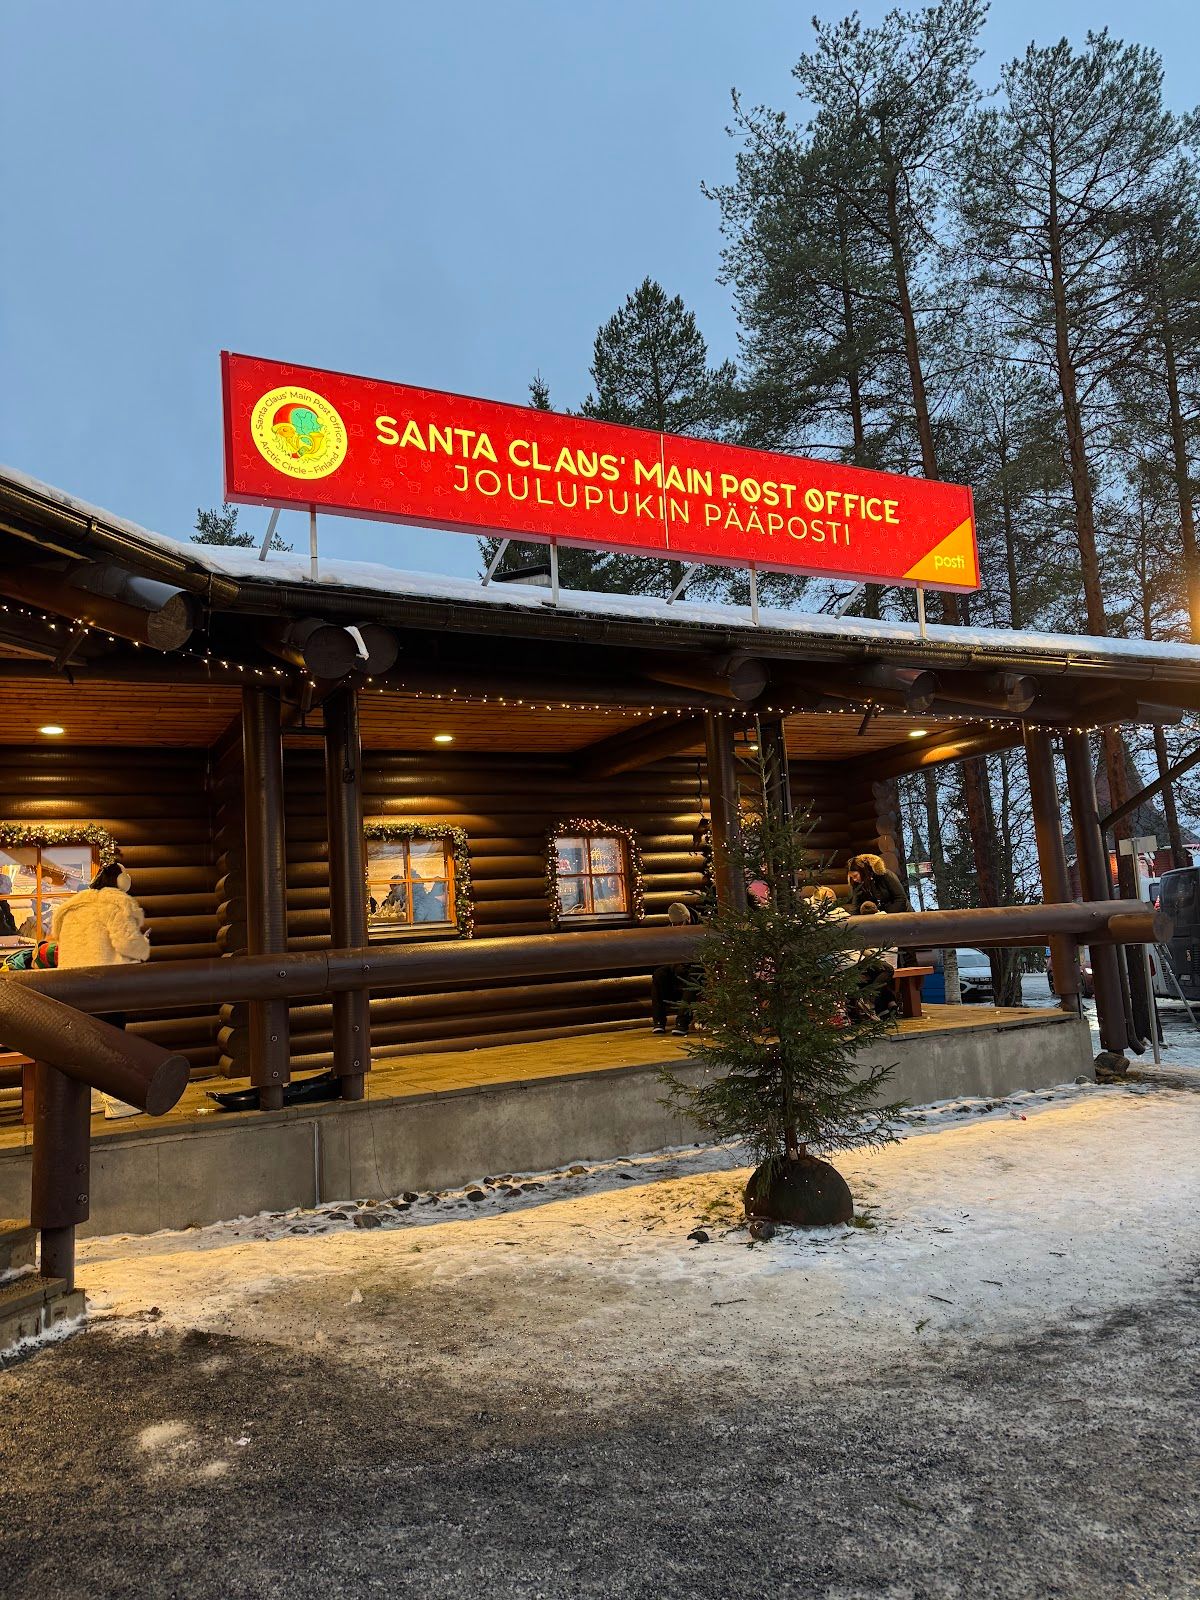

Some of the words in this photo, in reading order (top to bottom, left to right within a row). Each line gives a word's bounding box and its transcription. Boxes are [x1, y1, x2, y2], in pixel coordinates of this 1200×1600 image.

[256, 407, 268, 430] Santa
[265, 392, 288, 407] Claus'
[290, 391, 312, 402] Main
[313, 398, 331, 416] Post
[329, 415, 343, 443] Office
[261, 440, 280, 464] Arctic
[281, 461, 307, 474] Circle
[313, 451, 339, 473] Finland
[375, 415, 499, 463] SANTA
[508, 439, 626, 482] CLAUS'
[634, 459, 714, 497] MAIN
[720, 473, 797, 509] POST
[804, 488, 900, 525] OFFICE
[453, 464, 690, 524] JOULUPUKIN
[704, 501, 850, 546] PÄÄPOSTI
[934, 555, 965, 571] posti
